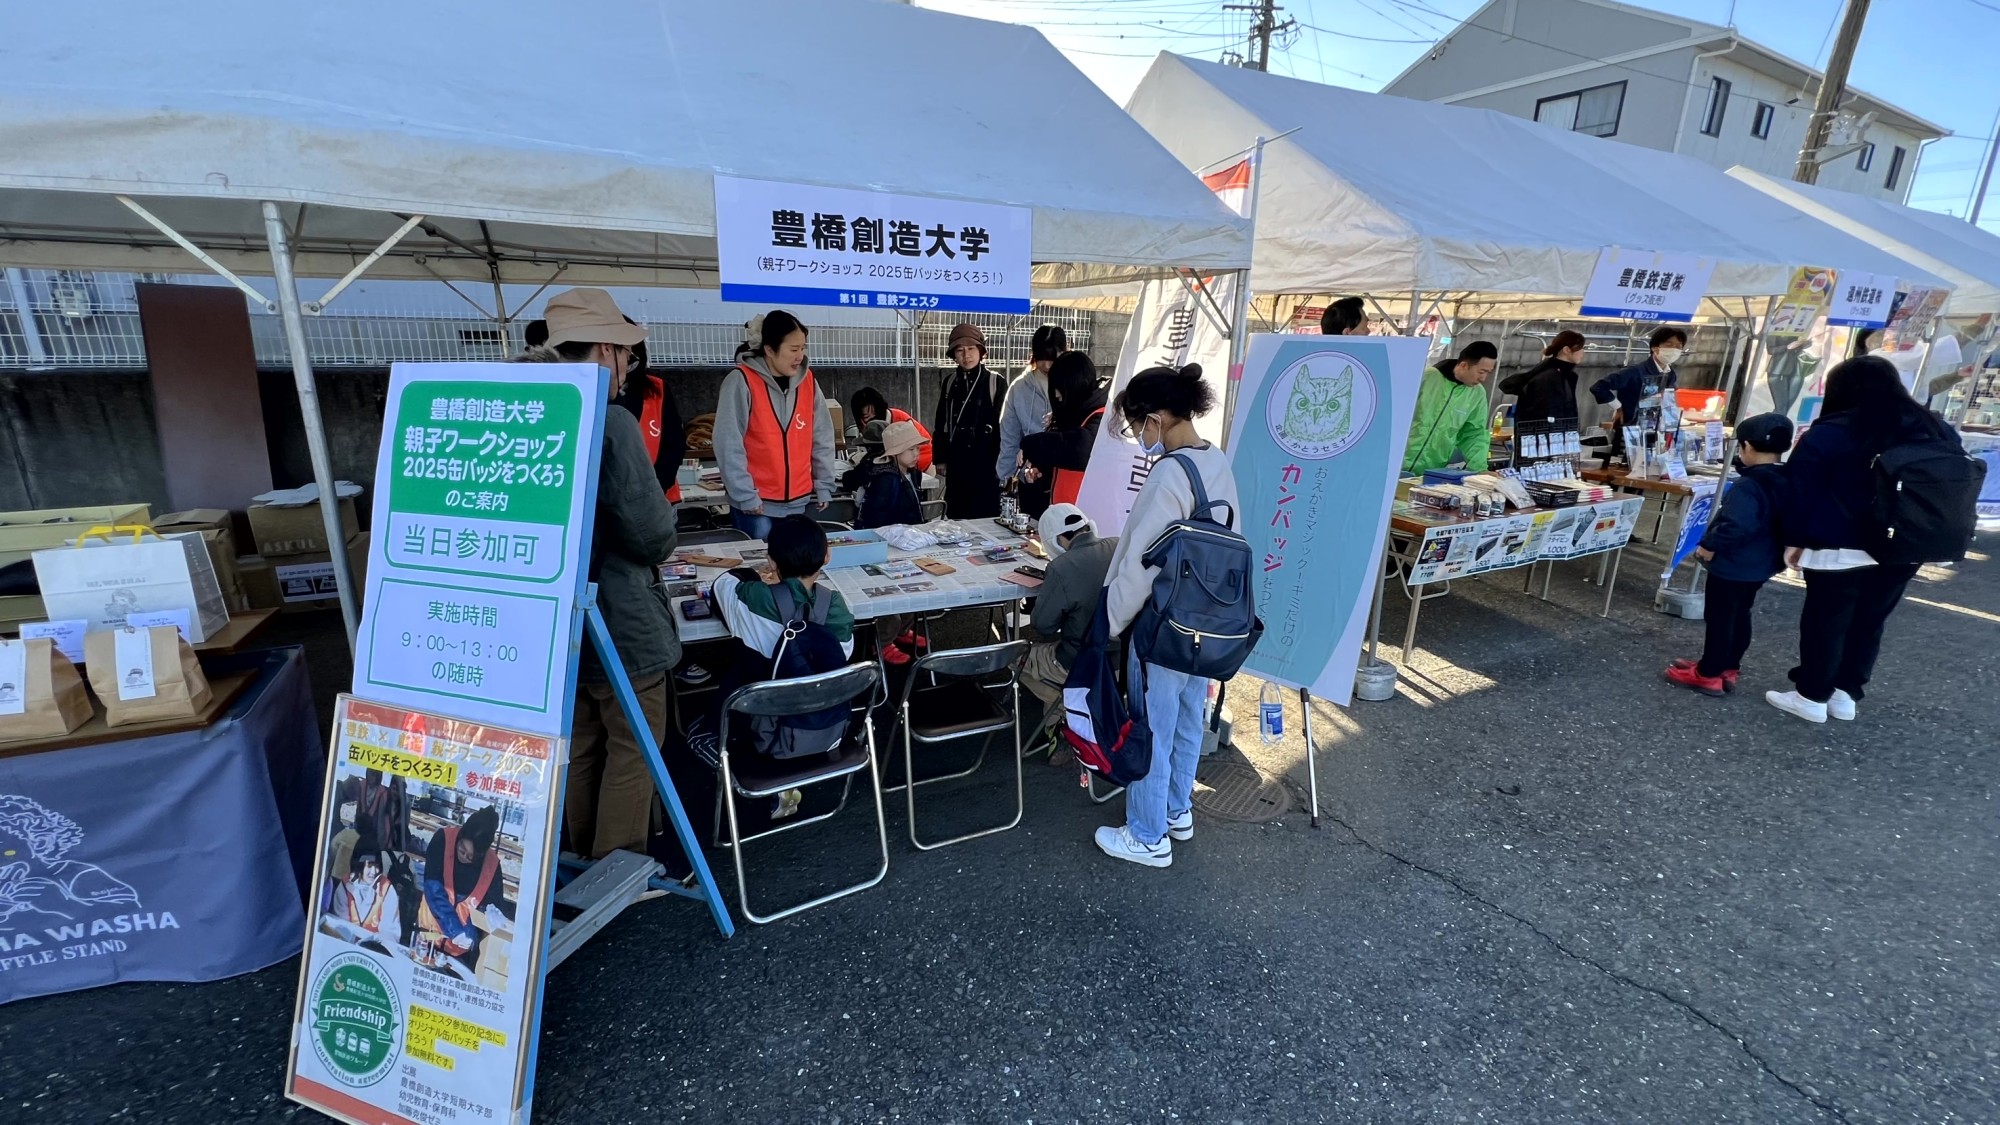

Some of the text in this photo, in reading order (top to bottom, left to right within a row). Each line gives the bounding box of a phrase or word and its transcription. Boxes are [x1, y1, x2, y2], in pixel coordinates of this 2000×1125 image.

[771, 209, 989, 261] 豊橋創造大学
[840, 293, 939, 308] 第1回 豊鉄フェスタ
[430, 398, 545, 424] 豊橋創造大学
[404, 426, 566, 460] 親子ワークショップ
[403, 456, 565, 487] 2025缶バッジをつくろう
[445, 490, 509, 511] のご案内
[263, 539, 317, 552] ASKUL
[403, 523, 540, 565] 当日参加可
[427, 600, 498, 629] 実施時間
[431, 661, 484, 687] の随時
[348, 744, 454, 784] 缶バッチをつくろう！
[466, 771, 522, 799] 参加無料
[45, 911, 180, 942] WASHA
[0, 939, 128, 972] FFLE STAND
[324, 1003, 386, 1029] Friendship
[402, 1064, 417, 1077] 出展
[401, 1077, 493, 1118] 豊橋創造大学短期大学部
